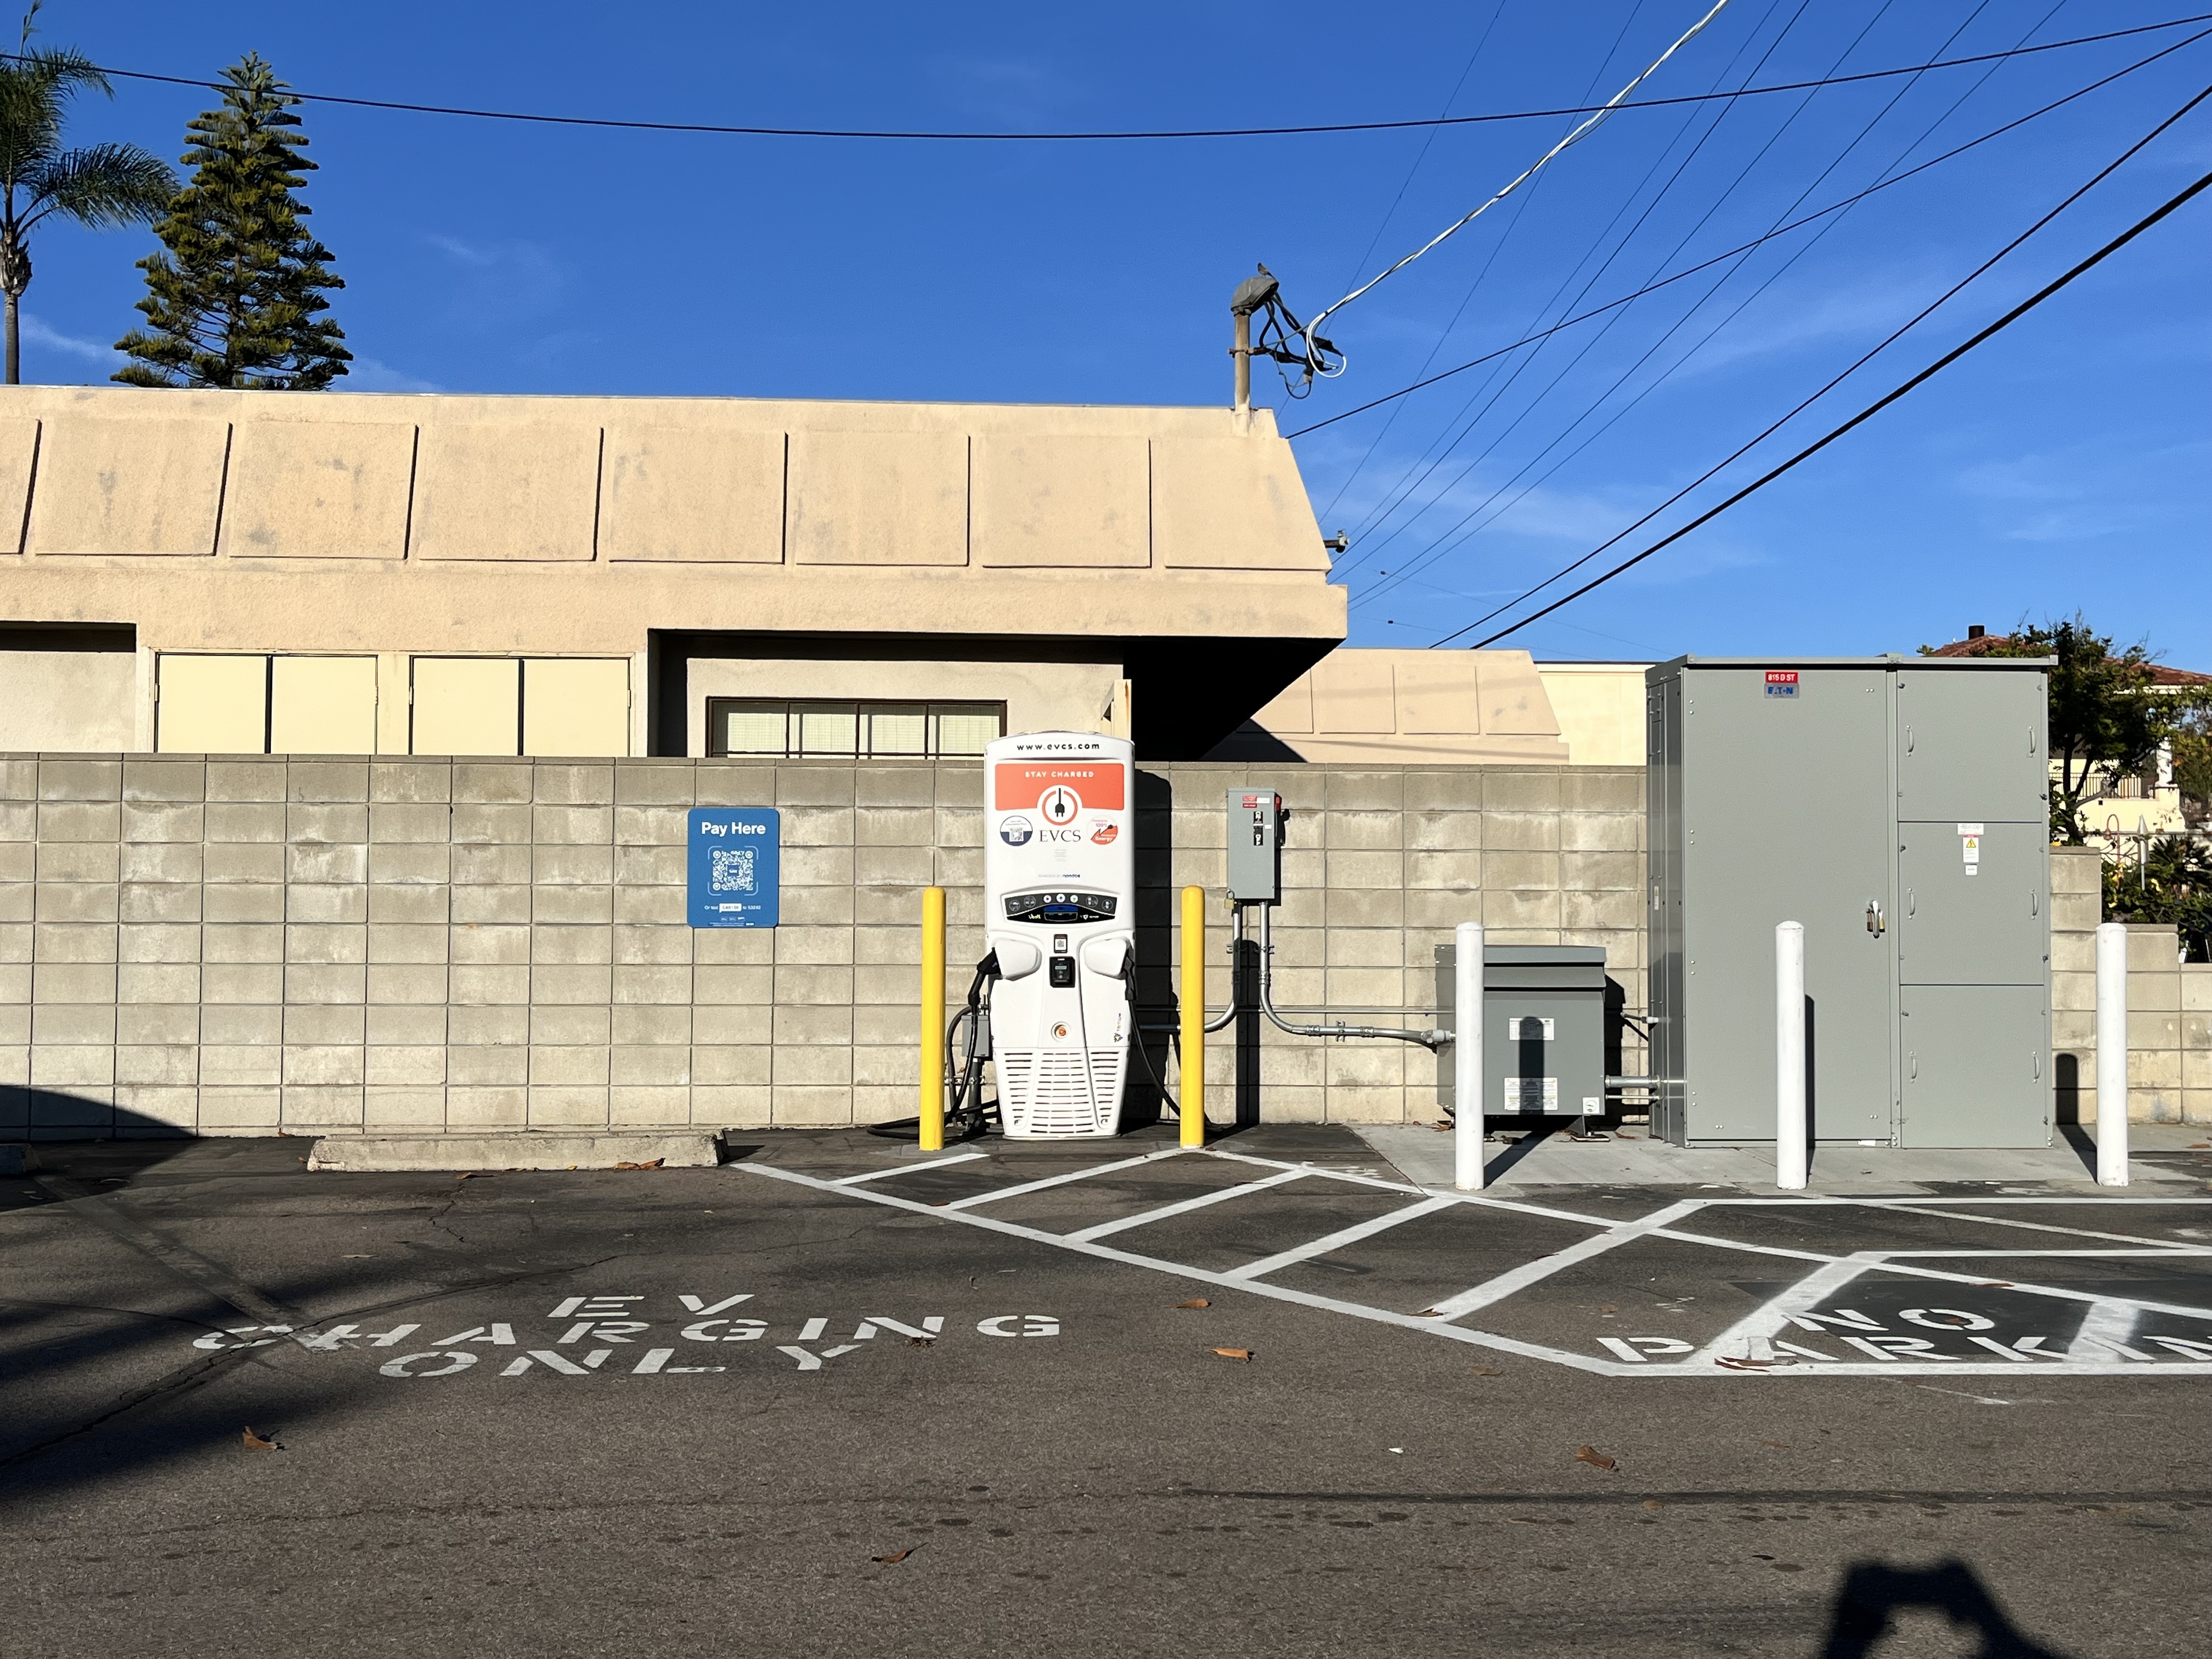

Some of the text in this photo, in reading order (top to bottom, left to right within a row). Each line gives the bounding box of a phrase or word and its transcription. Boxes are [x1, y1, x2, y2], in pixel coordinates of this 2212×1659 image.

[701, 821, 766, 837] Pay Here
[1039, 830, 1081, 842] EVCS
[548, 1294, 755, 1317] EV
[1781, 1308, 1995, 1331] NO
[193, 1314, 1060, 1350] CHARGING
[379, 1344, 862, 1378] ONLY
